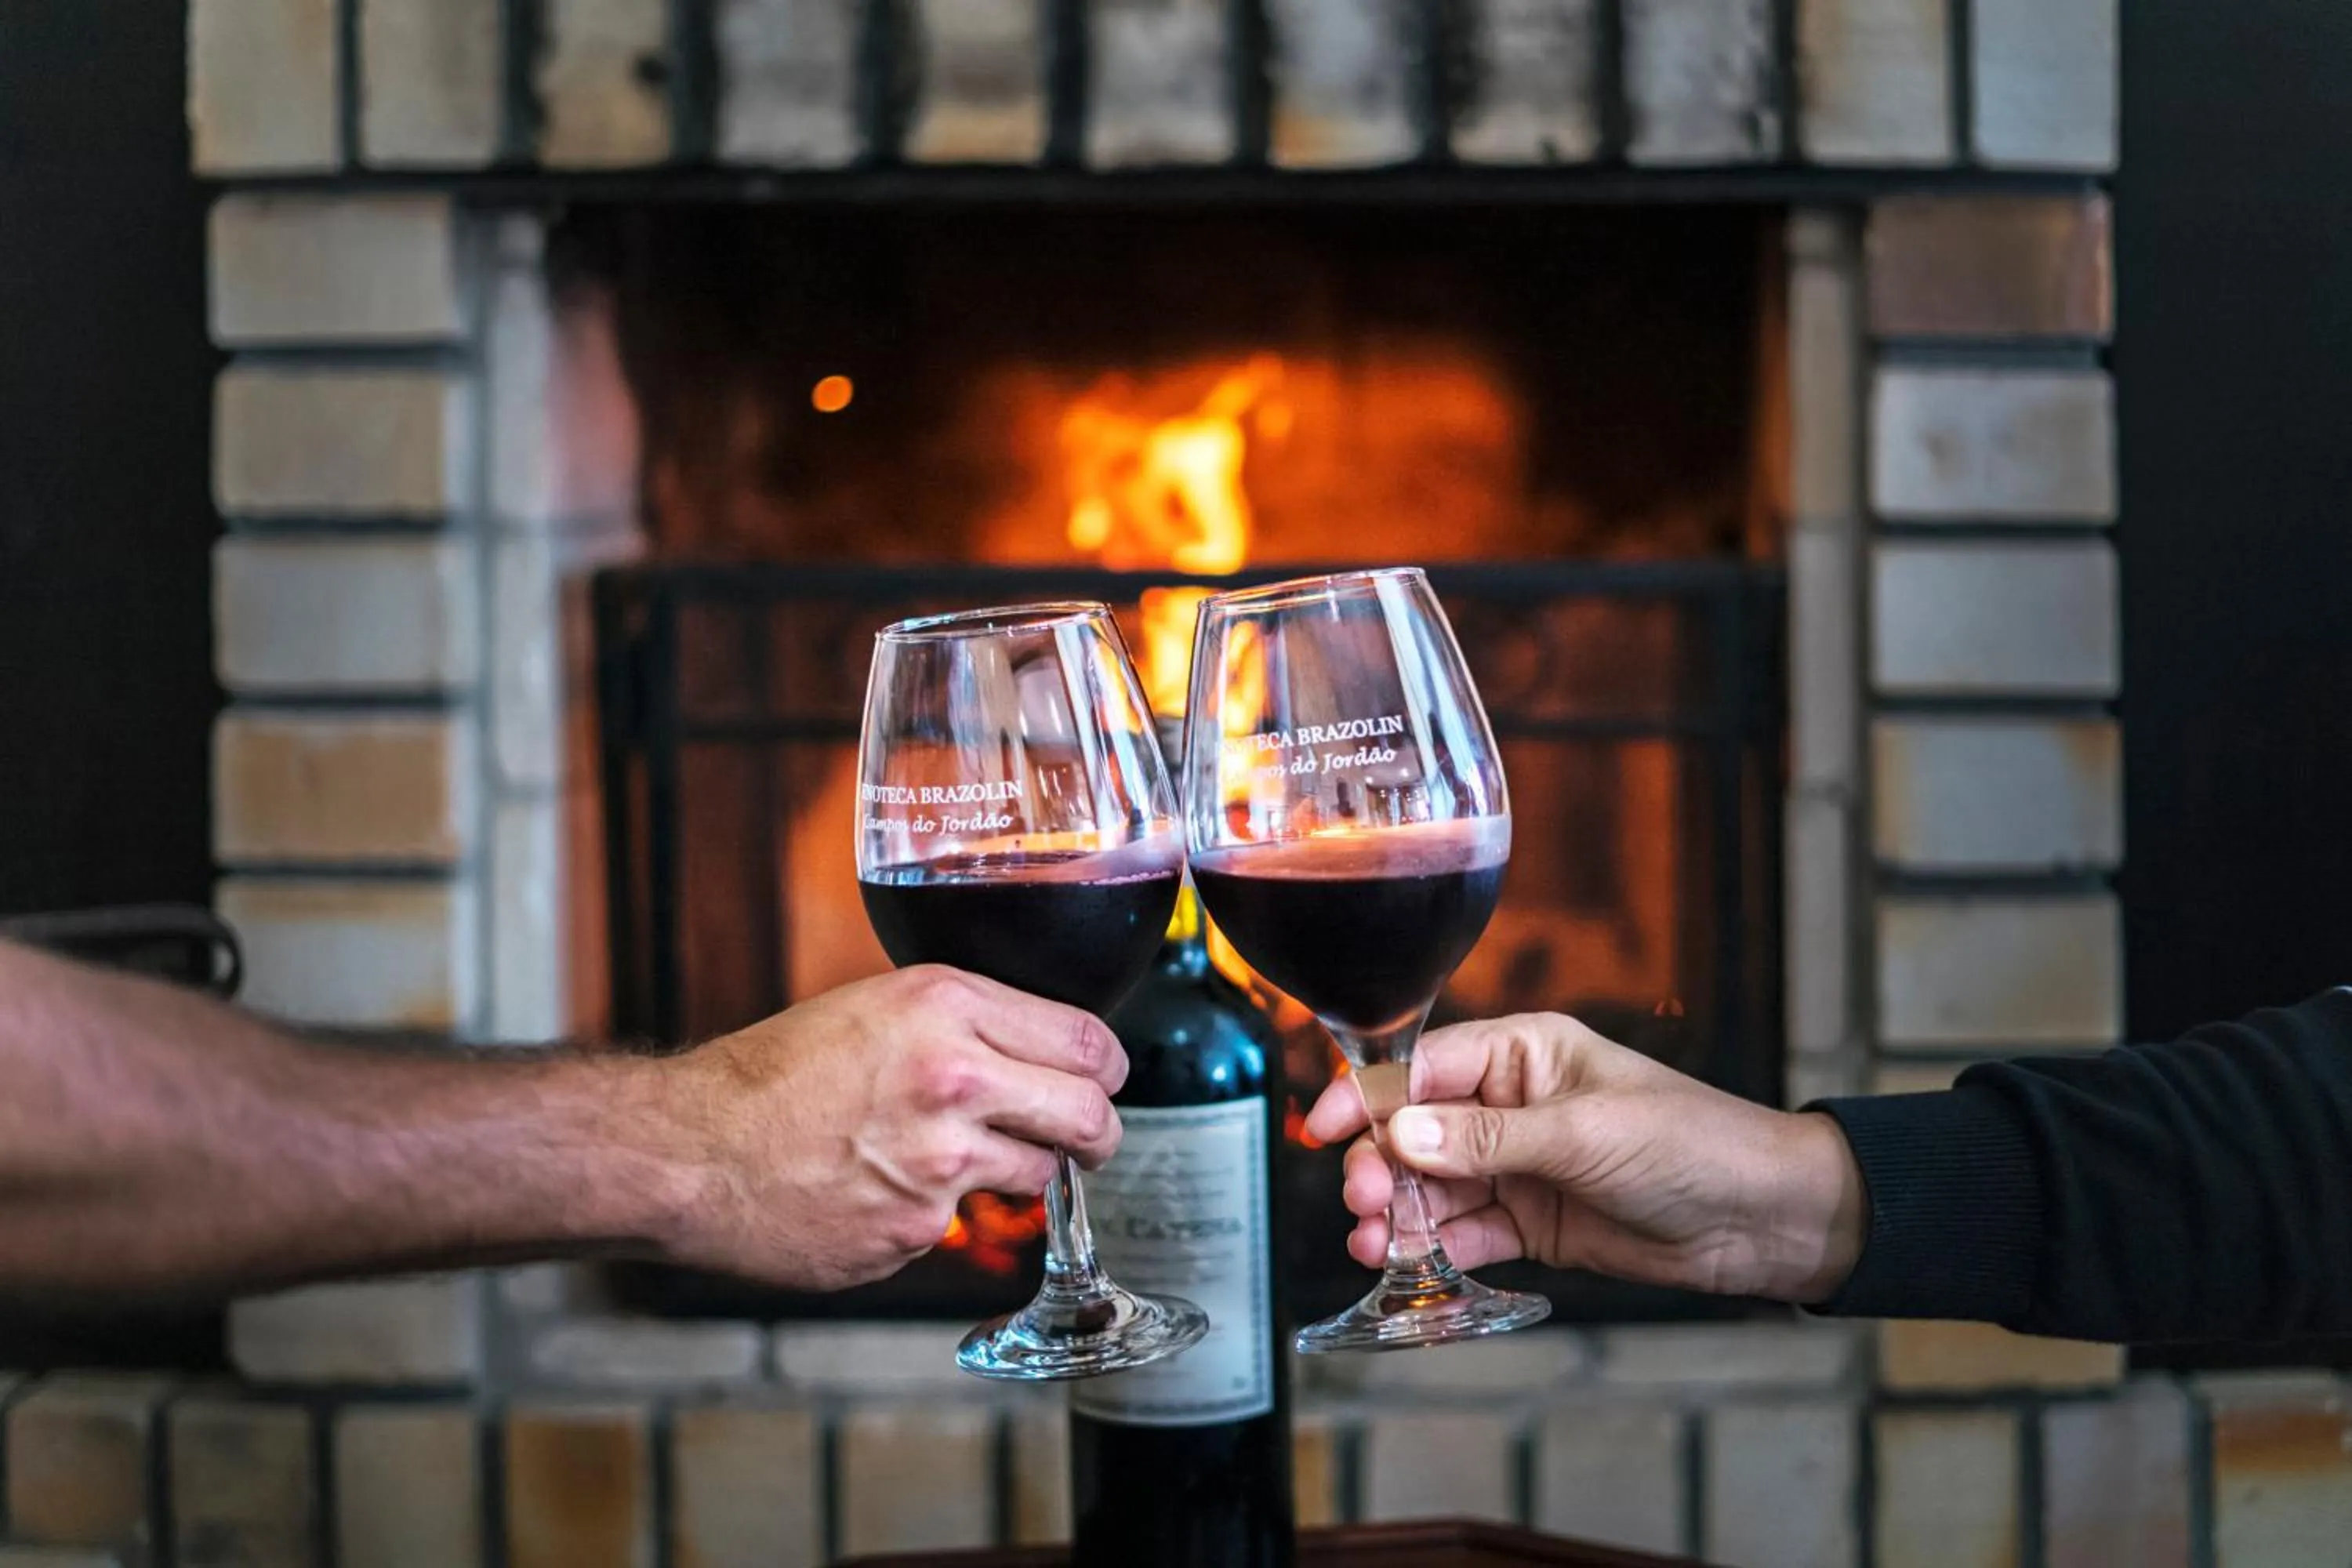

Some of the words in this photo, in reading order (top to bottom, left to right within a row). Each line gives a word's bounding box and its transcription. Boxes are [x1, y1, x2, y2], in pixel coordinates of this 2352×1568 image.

[1297, 715, 1404, 746] BRAZOLIN
[1290, 756, 1317, 775] do
[1322, 747, 1396, 775] Jordão
[920, 781, 1022, 804] BRAZOLIN
[913, 815, 937, 833] do
[940, 812, 1013, 836] Jordão
